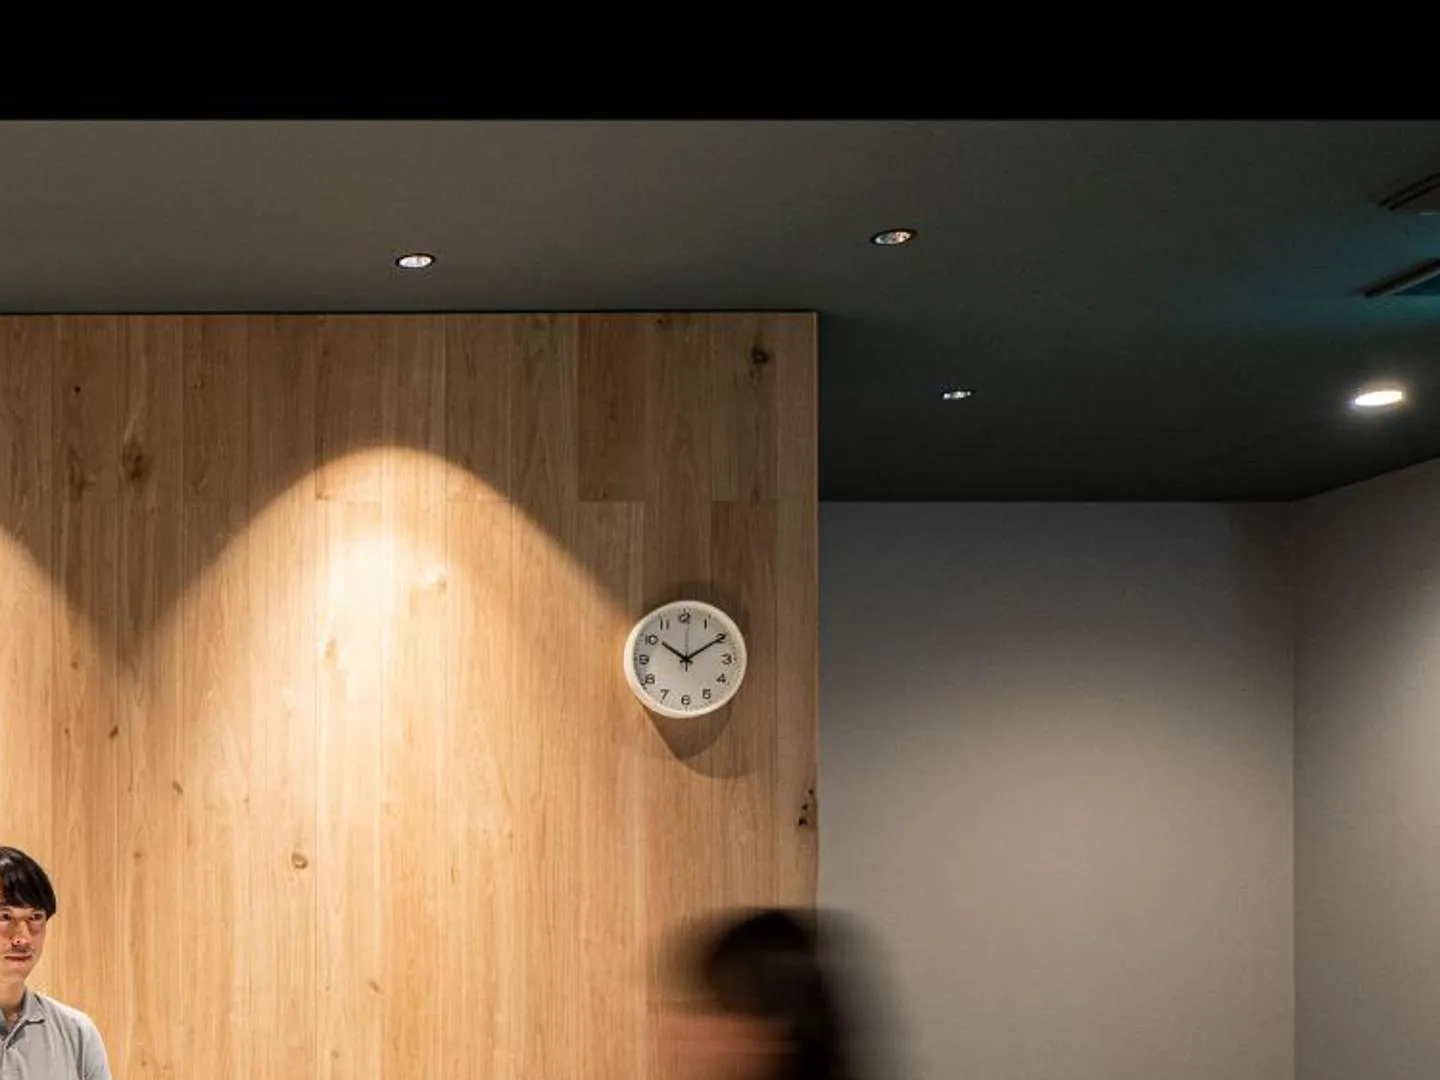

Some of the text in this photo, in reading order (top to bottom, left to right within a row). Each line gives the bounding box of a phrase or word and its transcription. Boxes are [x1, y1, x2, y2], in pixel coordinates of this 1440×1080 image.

[703, 619, 708, 631] 1
[645, 634, 659, 645] 10
[639, 654, 649, 665] 9
[722, 653, 733, 665] 3
[645, 674, 655, 684] 8
[716, 673, 727, 683] 4
[660, 689, 669, 700] 7
[702, 689, 711, 699] 5
[681, 695, 691, 705] 6
